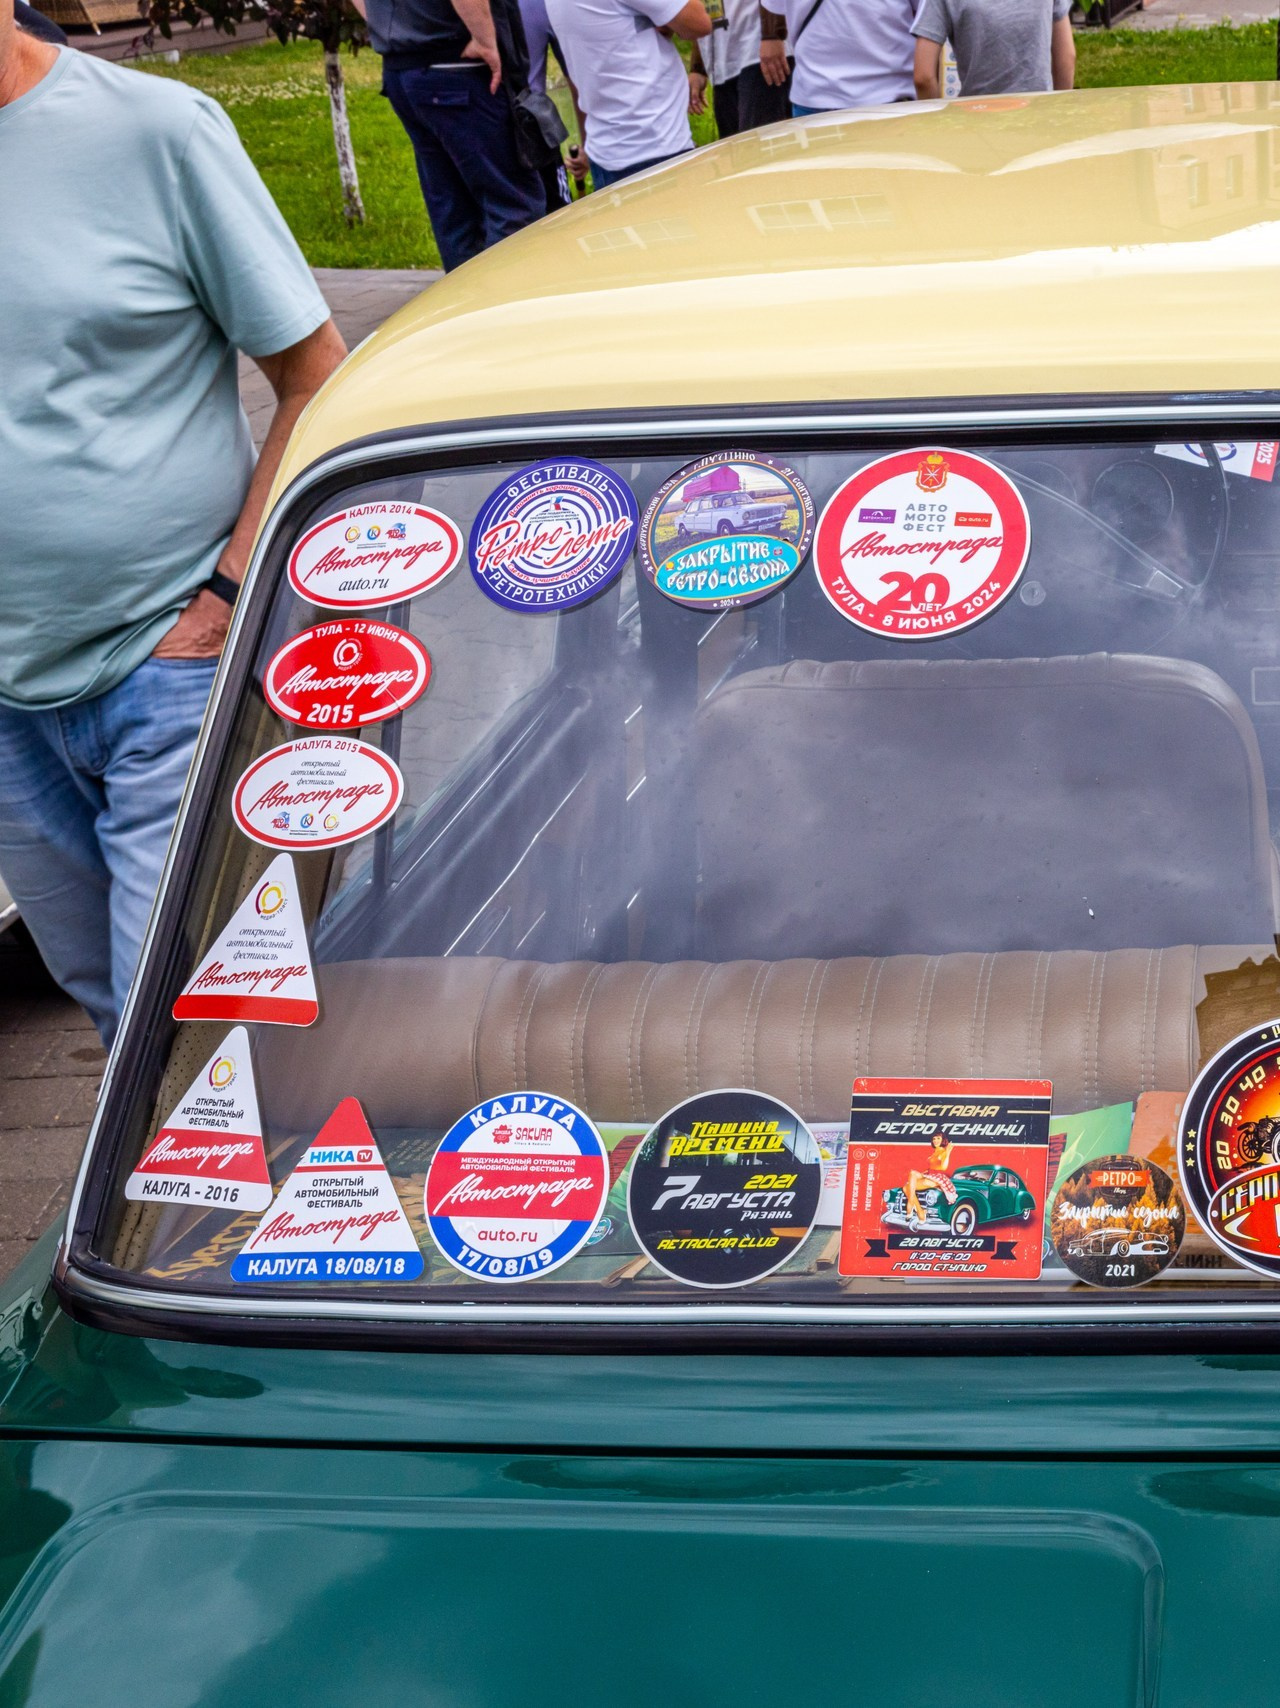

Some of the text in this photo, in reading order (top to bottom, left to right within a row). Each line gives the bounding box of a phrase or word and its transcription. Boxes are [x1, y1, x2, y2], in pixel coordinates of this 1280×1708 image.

[507, 466, 609, 498] ФЕСТИВАЛЬ
[349, 504, 413, 519] КАЛУГА 2014
[905, 503, 948, 512] АВТО
[904, 513, 946, 522] МОТО
[903, 522, 945, 533] ФЕСТ
[840, 530, 1003, 565] Автострада
[303, 540, 444, 583] Автострада
[676, 541, 770, 571] ЗАКРЫТИЕ
[338, 577, 390, 592] auto.ru
[489, 564, 608, 602] РЕТРОТЕХНИКИ
[877, 571, 950, 612] 20
[831, 576, 1001, 629] ТУЛА 8 ИЮНЯ 2024
[917, 603, 942, 612] ЛЕТ
[315, 623, 399, 642] ТУЛА 12 ИЮНЯ
[276, 663, 414, 700] Автострада
[306, 703, 354, 724] 2015
[294, 740, 359, 753] КАЛУГА 2015
[246, 780, 384, 817] Автострада
[239, 928, 287, 937] открытый
[226, 939, 294, 949] автомобильный
[233, 950, 278, 961] фестиваль
[187, 961, 308, 996] Автострада
[1239, 1065, 1267, 1092] 40
[195, 1097, 235, 1108] ОТКРЫТЫЙ
[181, 1107, 244, 1119] АВТОМОБИЛЬНЫЙ
[469, 1097, 576, 1131] КАЛУГА
[901, 1104, 1001, 1117] ВЫСТАВКА
[1220, 1095, 1240, 1127] 30
[188, 1117, 229, 1128] ФЕСТИВАЛЬ
[874, 1122, 1025, 1136] РЕТРО ТЕХНИКИ
[515, 1127, 553, 1141] SAKURA
[140, 1135, 254, 1170] Автострада
[309, 1151, 355, 1163] НИКА
[1215, 1140, 1233, 1170] 20
[460, 1164, 528, 1172] АВТОМОБИЛЬНЫЙ
[461, 1157, 576, 1166] МЕЖДУНАРОДНЫЙ ОТКРЫТЫЙ
[312, 1176, 364, 1187] ОТКРЫТЫЙ
[743, 1174, 798, 1190] 2021
[1102, 1172, 1135, 1186] РЕТРО
[142, 1180, 239, 1202] КАЛУГА 2016
[294, 1186, 379, 1198] АВТОМОБИЛЬНЫЙ
[432, 1173, 594, 1215] Автострада
[651, 1175, 796, 1211] 7 АВГУСТА
[307, 1199, 363, 1208] ФЕСТИВАЛЬ
[250, 1209, 400, 1250] Автострада
[477, 1229, 538, 1242] auto.ru
[657, 1236, 780, 1250] RETROCAR CLUB
[899, 1236, 984, 1248] 28 АВГУСТА
[456, 1245, 553, 1275] 17/08/19
[909, 1251, 971, 1261] 11:00-16:00
[247, 1257, 405, 1275] КАЛУГА 18/08/18
[892, 1261, 987, 1272] ГОРОД СТУПИНО
[1105, 1264, 1135, 1277] 2021
